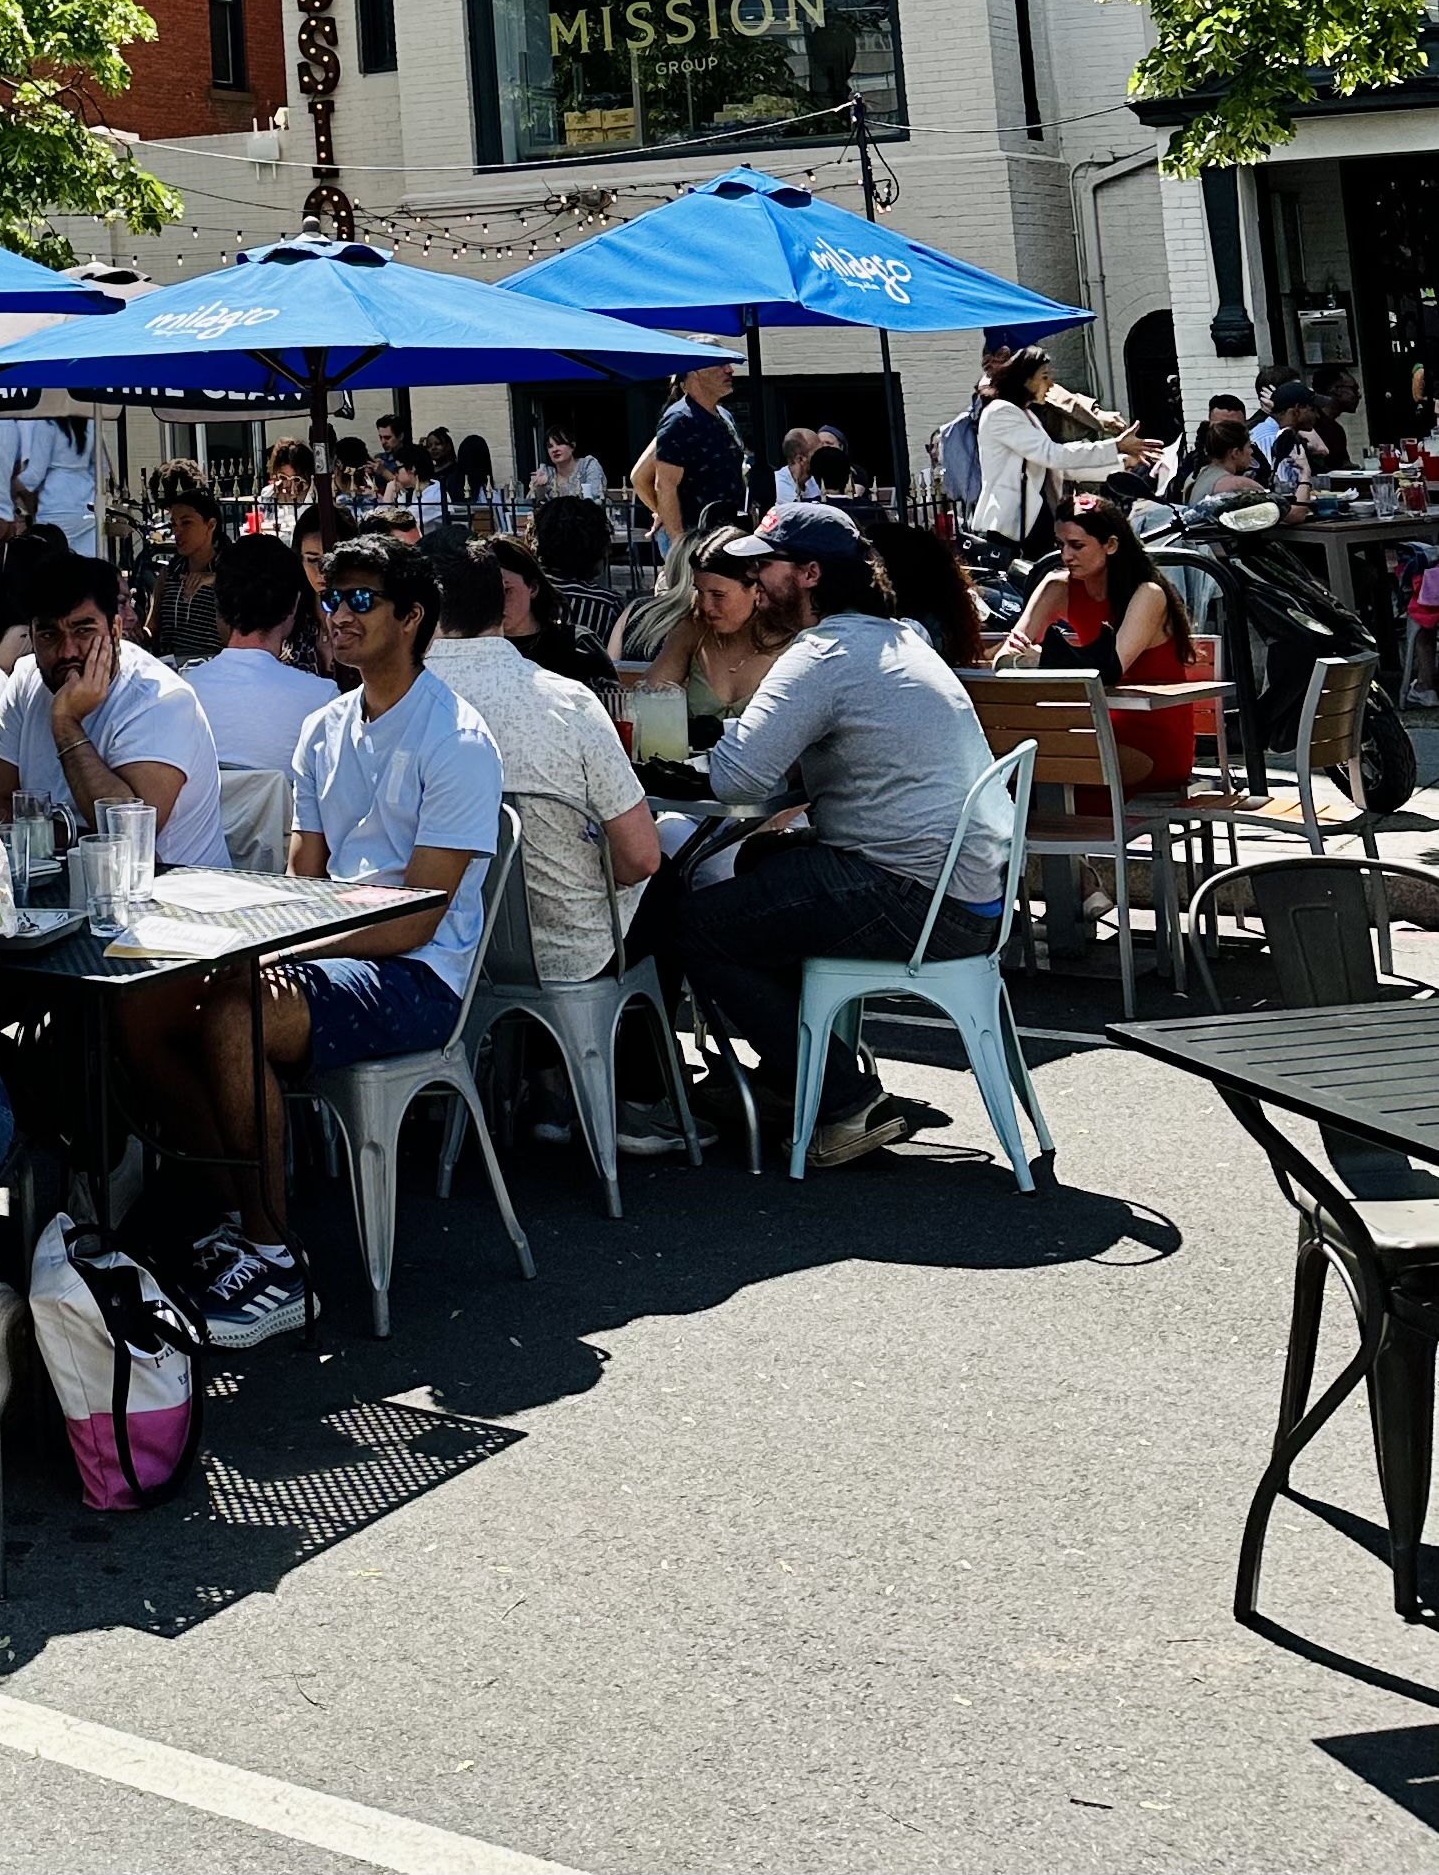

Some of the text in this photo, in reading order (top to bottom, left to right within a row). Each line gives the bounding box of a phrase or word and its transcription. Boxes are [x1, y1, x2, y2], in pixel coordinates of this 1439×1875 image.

[655, 55, 719, 76] GROUP
[809, 236, 912, 305] milagro
[144, 300, 280, 340] milagro
